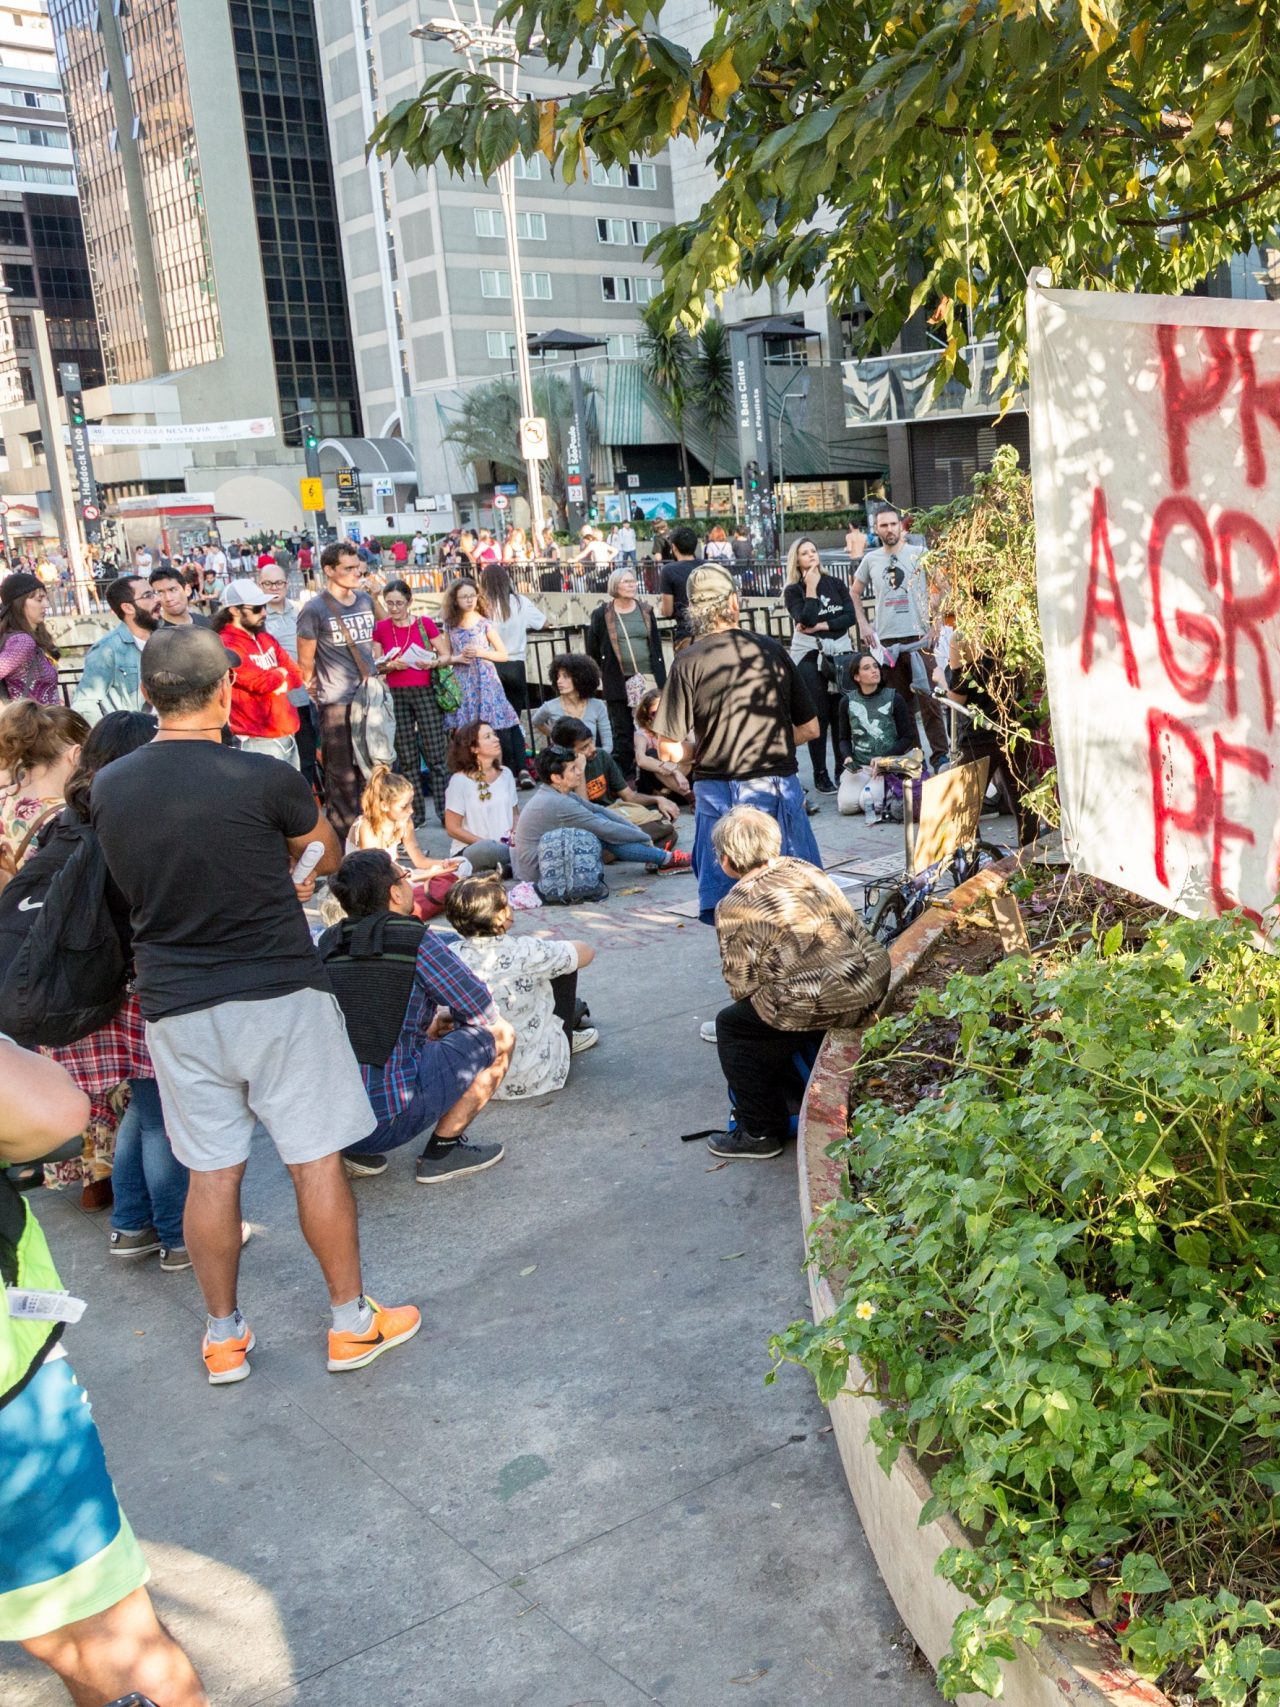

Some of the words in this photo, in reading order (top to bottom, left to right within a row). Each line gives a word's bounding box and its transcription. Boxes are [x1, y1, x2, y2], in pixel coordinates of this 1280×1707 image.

[737, 360, 747, 392] Cintra
[740, 393, 750, 416] Bela
[753, 388, 762, 428] Paulista
[741, 417, 750, 427] R.
[74, 427, 85, 452] Lobo
[77, 454, 92, 496] Haddock
[83, 497, 92, 506] R.
[1079, 485, 1141, 690] A
[329, 617, 356, 631] BST
[332, 629, 358, 643] DD
